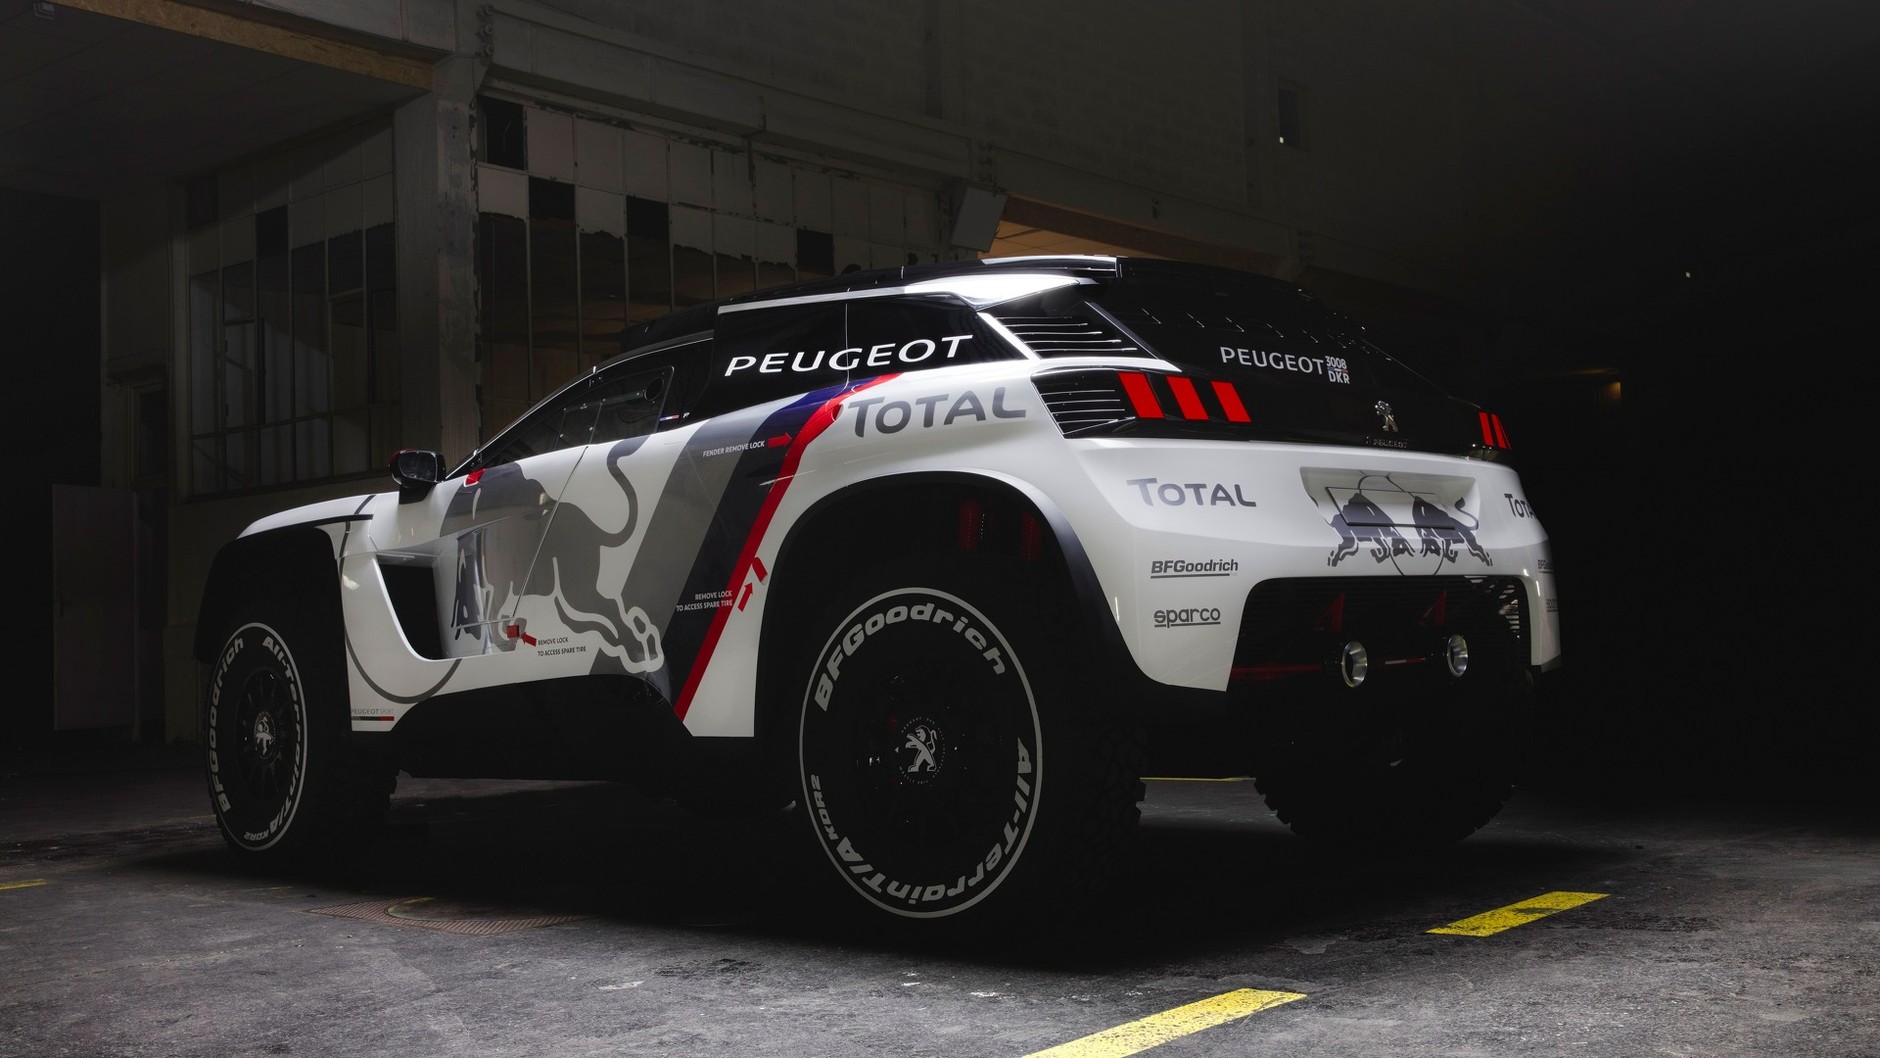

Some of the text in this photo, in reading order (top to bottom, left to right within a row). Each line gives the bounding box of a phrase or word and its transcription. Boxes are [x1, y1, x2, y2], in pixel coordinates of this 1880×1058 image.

[724, 334, 973, 377] PEUGEOT
[1219, 346, 1324, 375] PEUGEOT
[1325, 355, 1347, 369] 3008
[1328, 370, 1350, 384] DKR
[847, 386, 1027, 438] TOTAL
[702, 440, 765, 458] FENDER REMOVE LOCK
[1372, 438, 1409, 449] PEUGEOT
[1126, 477, 1256, 508] TOTAL
[1151, 558, 1239, 574] BFGoodrich
[695, 590, 732, 600] REMOVE LOCK
[676, 604, 684, 612] TO
[684, 602, 703, 611] ACCESS
[703, 600, 720, 609] SPARE
[1154, 607, 1221, 628] sparco
[814, 602, 1006, 712] BFGoodrich
[208, 637, 244, 813] BFGoodrich
[810, 774, 839, 841] KDR2
[243, 829, 270, 841] KDR2
